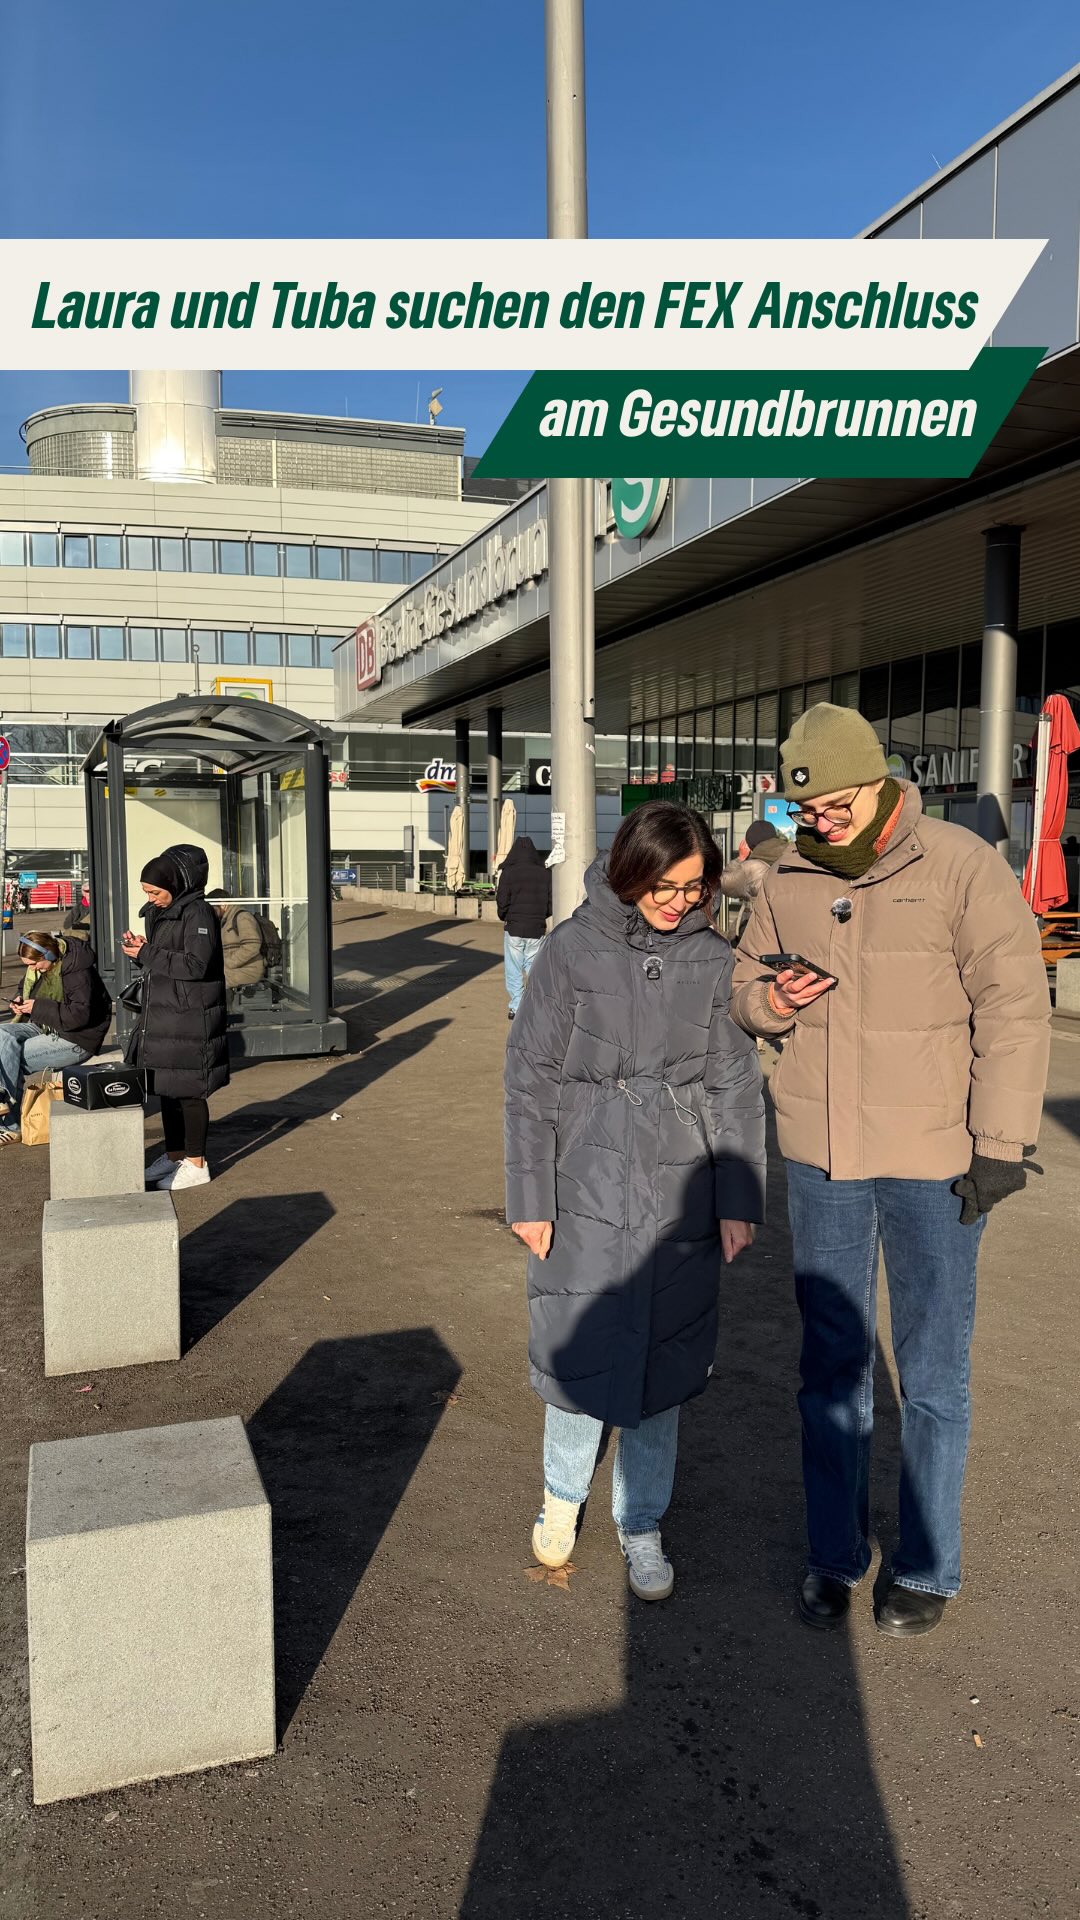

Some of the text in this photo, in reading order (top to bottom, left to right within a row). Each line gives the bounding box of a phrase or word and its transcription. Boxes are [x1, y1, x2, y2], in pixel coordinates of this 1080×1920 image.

[380, 518, 549, 666] Berlin-Gesundbrun
[426, 760, 457, 780] dm
[912, 743, 1024, 787] SANIFR
